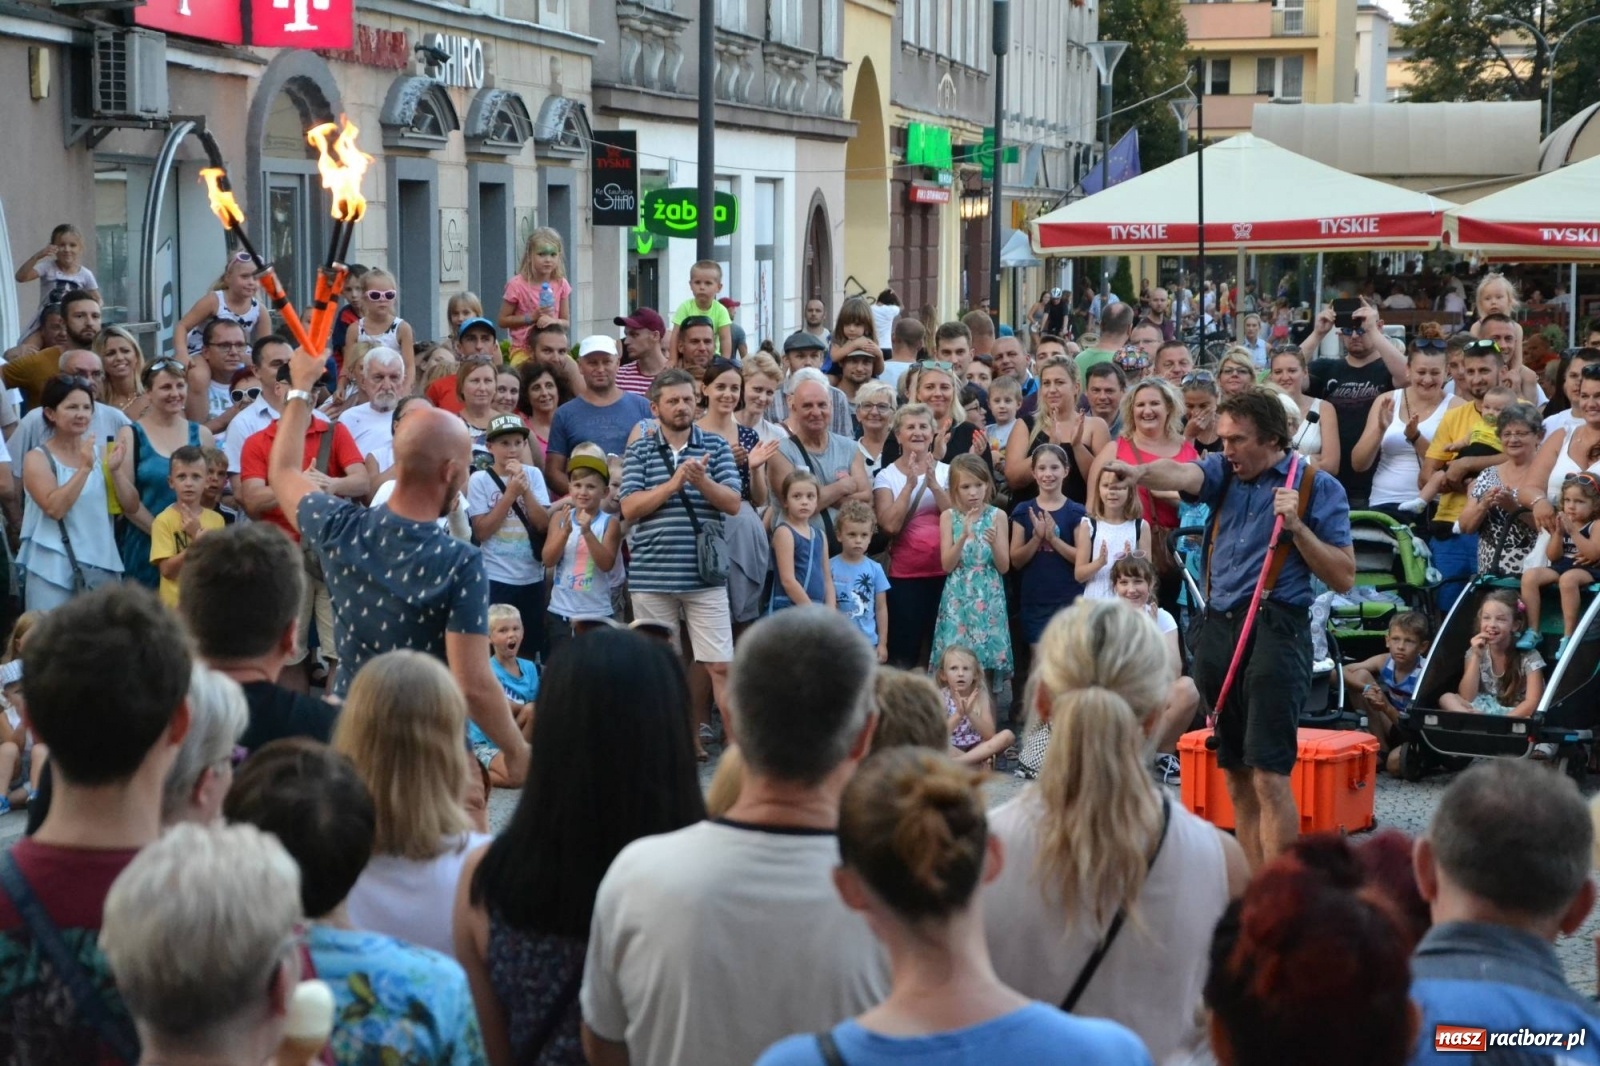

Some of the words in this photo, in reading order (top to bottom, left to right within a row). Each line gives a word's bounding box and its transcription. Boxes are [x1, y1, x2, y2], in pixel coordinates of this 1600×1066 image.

[434, 32, 485, 89] SHIRO
[595, 158, 631, 168] TYSKIE
[653, 198, 727, 222] żaba
[1107, 224, 1168, 240] TYSKIE
[1317, 217, 1380, 234] TYSKIE
[1539, 227, 1600, 243] TYSKI
[491, 415, 505, 431] NEW
